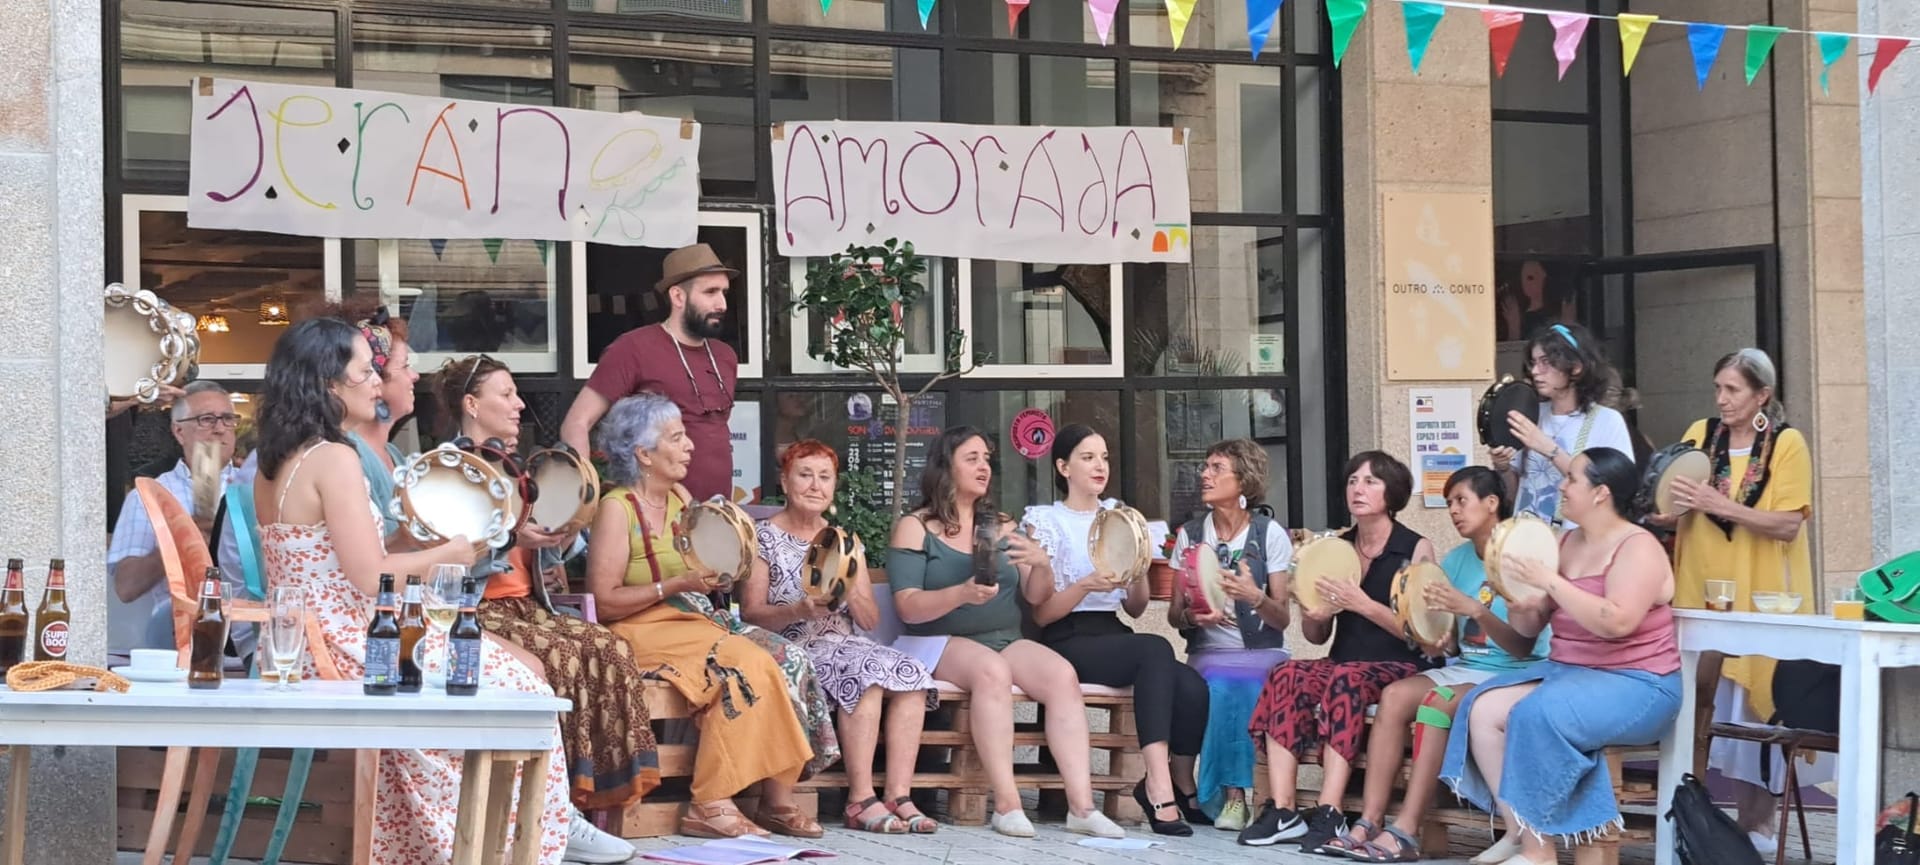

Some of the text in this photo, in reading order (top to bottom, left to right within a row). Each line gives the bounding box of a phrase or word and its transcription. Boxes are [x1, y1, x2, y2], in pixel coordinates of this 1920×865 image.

[1392, 283, 1485, 295] OUTRO CONTO
[1416, 432, 1435, 441] ESPAZO
[1417, 444, 1427, 452] CON
